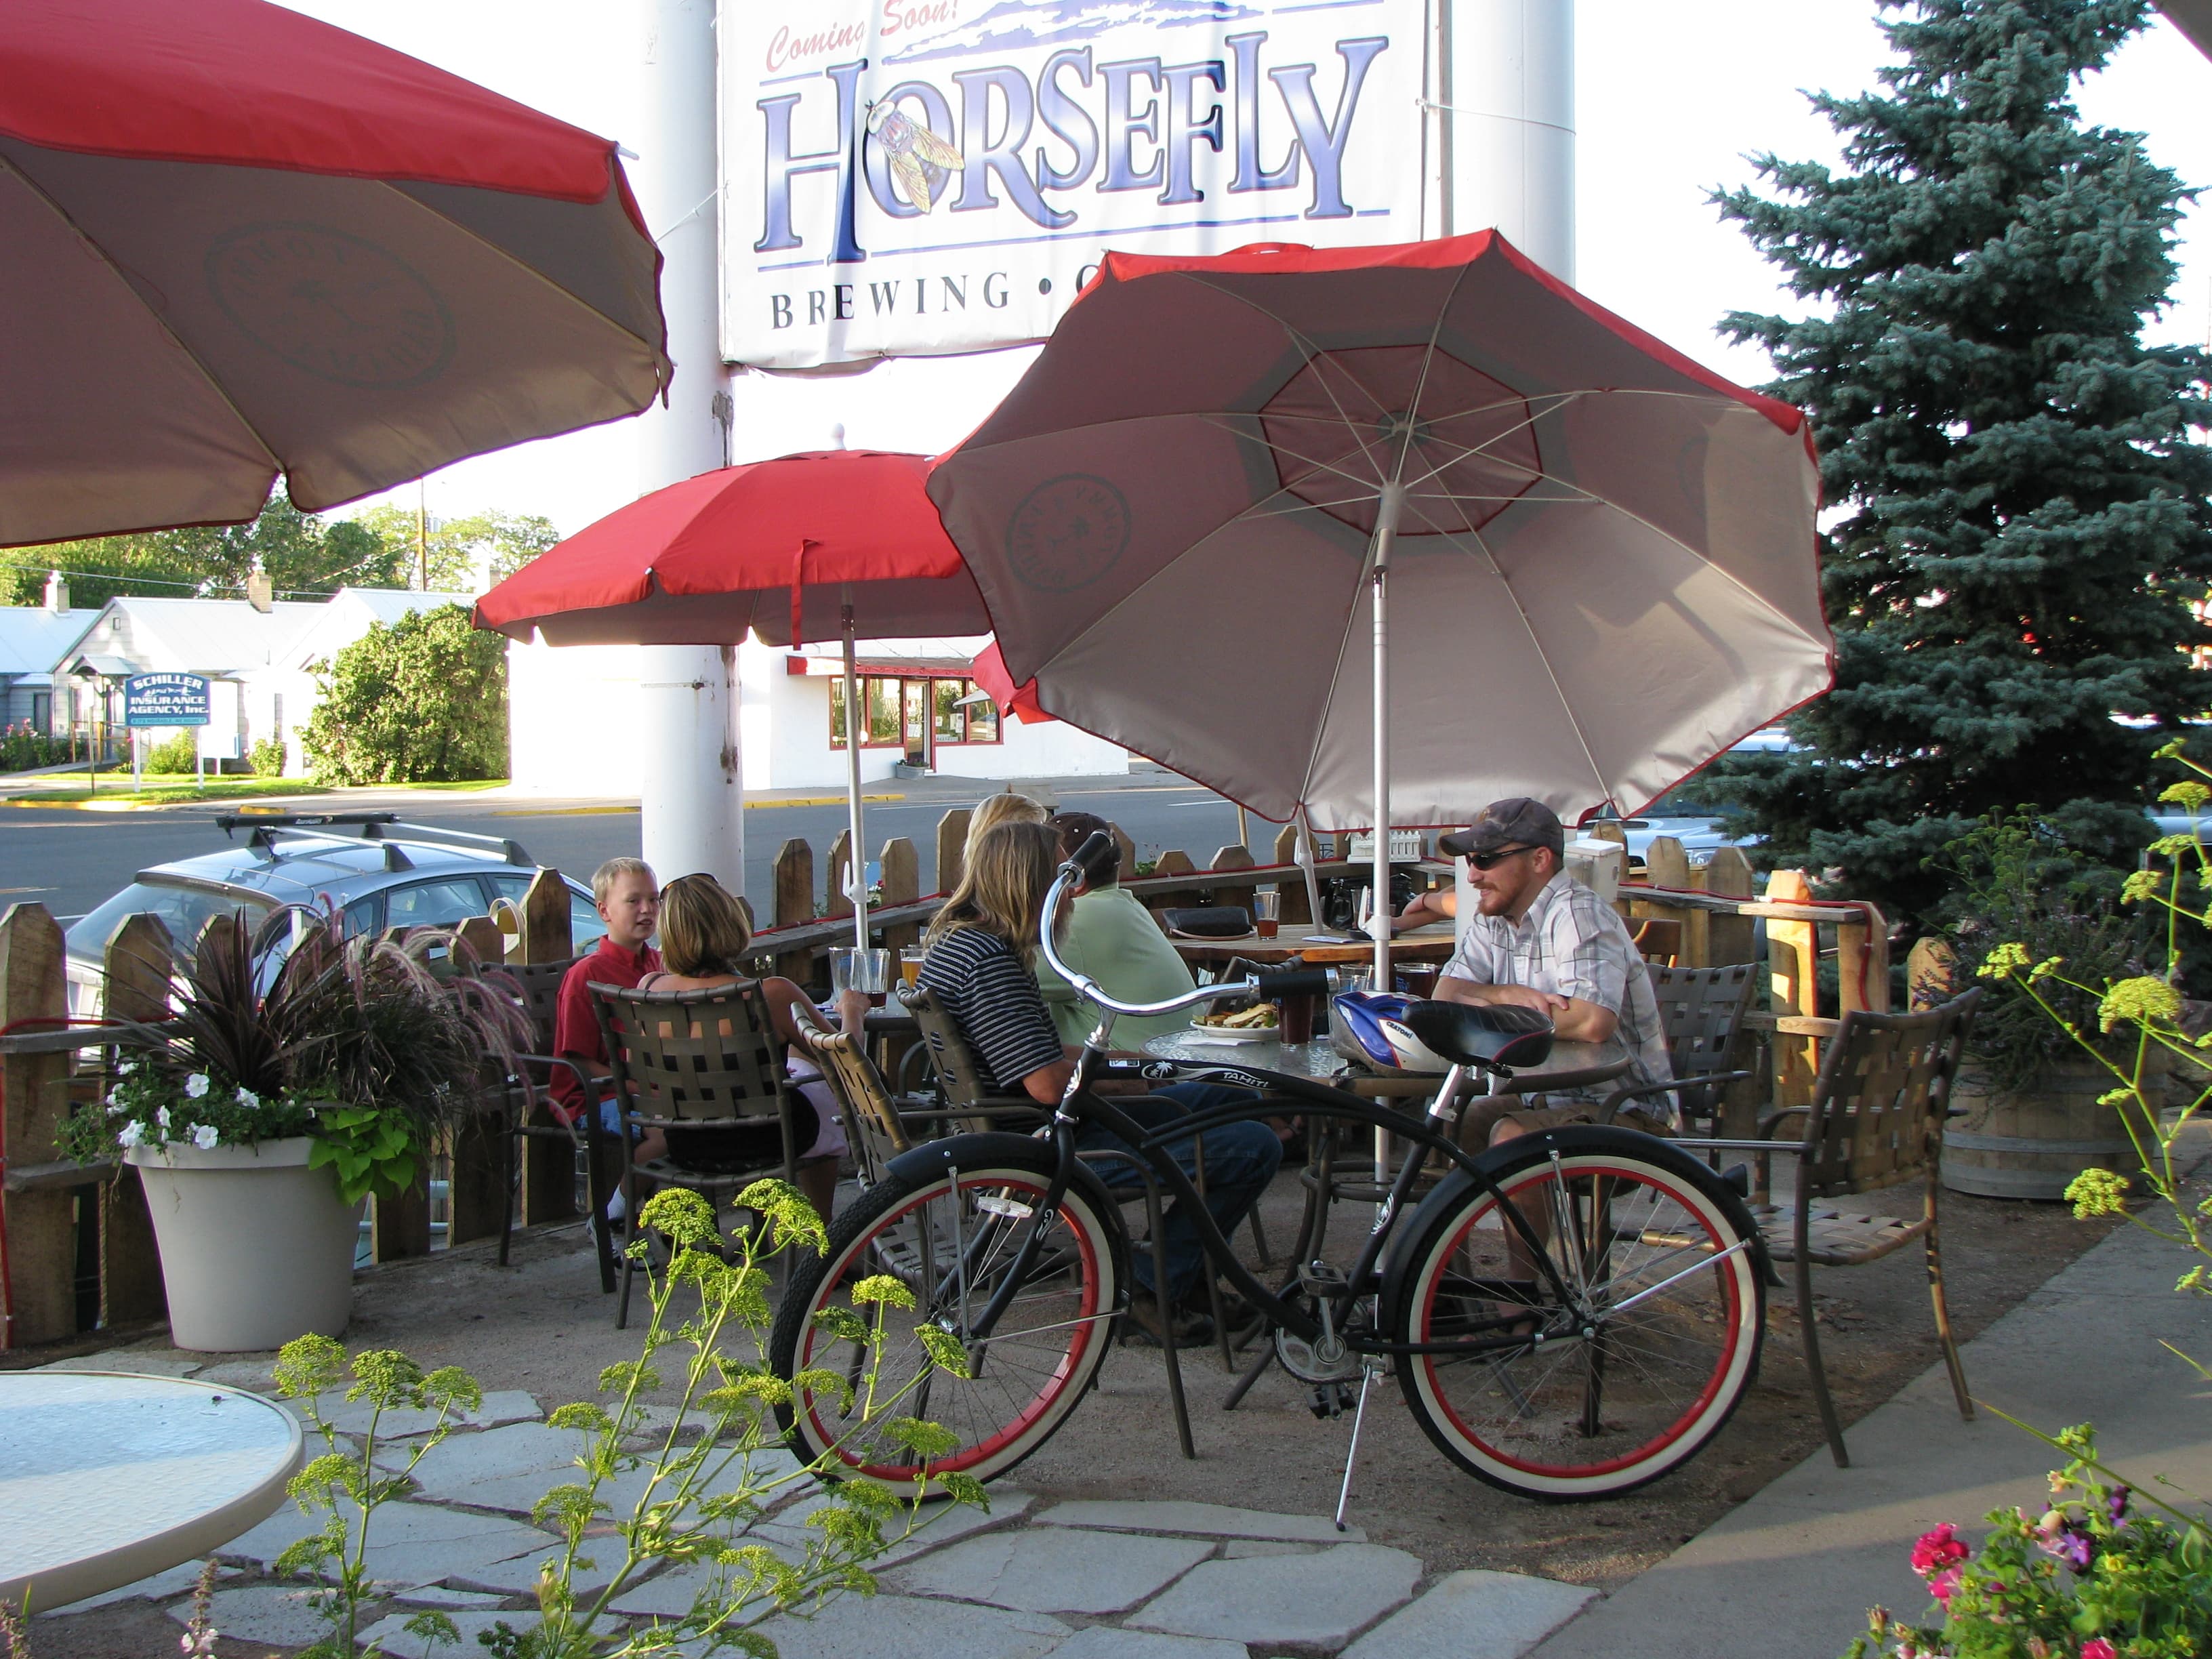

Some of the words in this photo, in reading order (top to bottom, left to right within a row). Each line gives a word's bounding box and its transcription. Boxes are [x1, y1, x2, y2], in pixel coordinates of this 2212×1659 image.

[766, 21, 865, 73] Coming
[754, 30, 1388, 266] HORSEFLY
[771, 271, 1010, 330] BREWING
[133, 674, 203, 691] SCHILLER
[131, 696, 206, 705] INSURANCE
[129, 705, 182, 714] AGENCY,
[185, 705, 209, 714] Inc.
[1223, 1071, 1269, 1088] TAHITI
